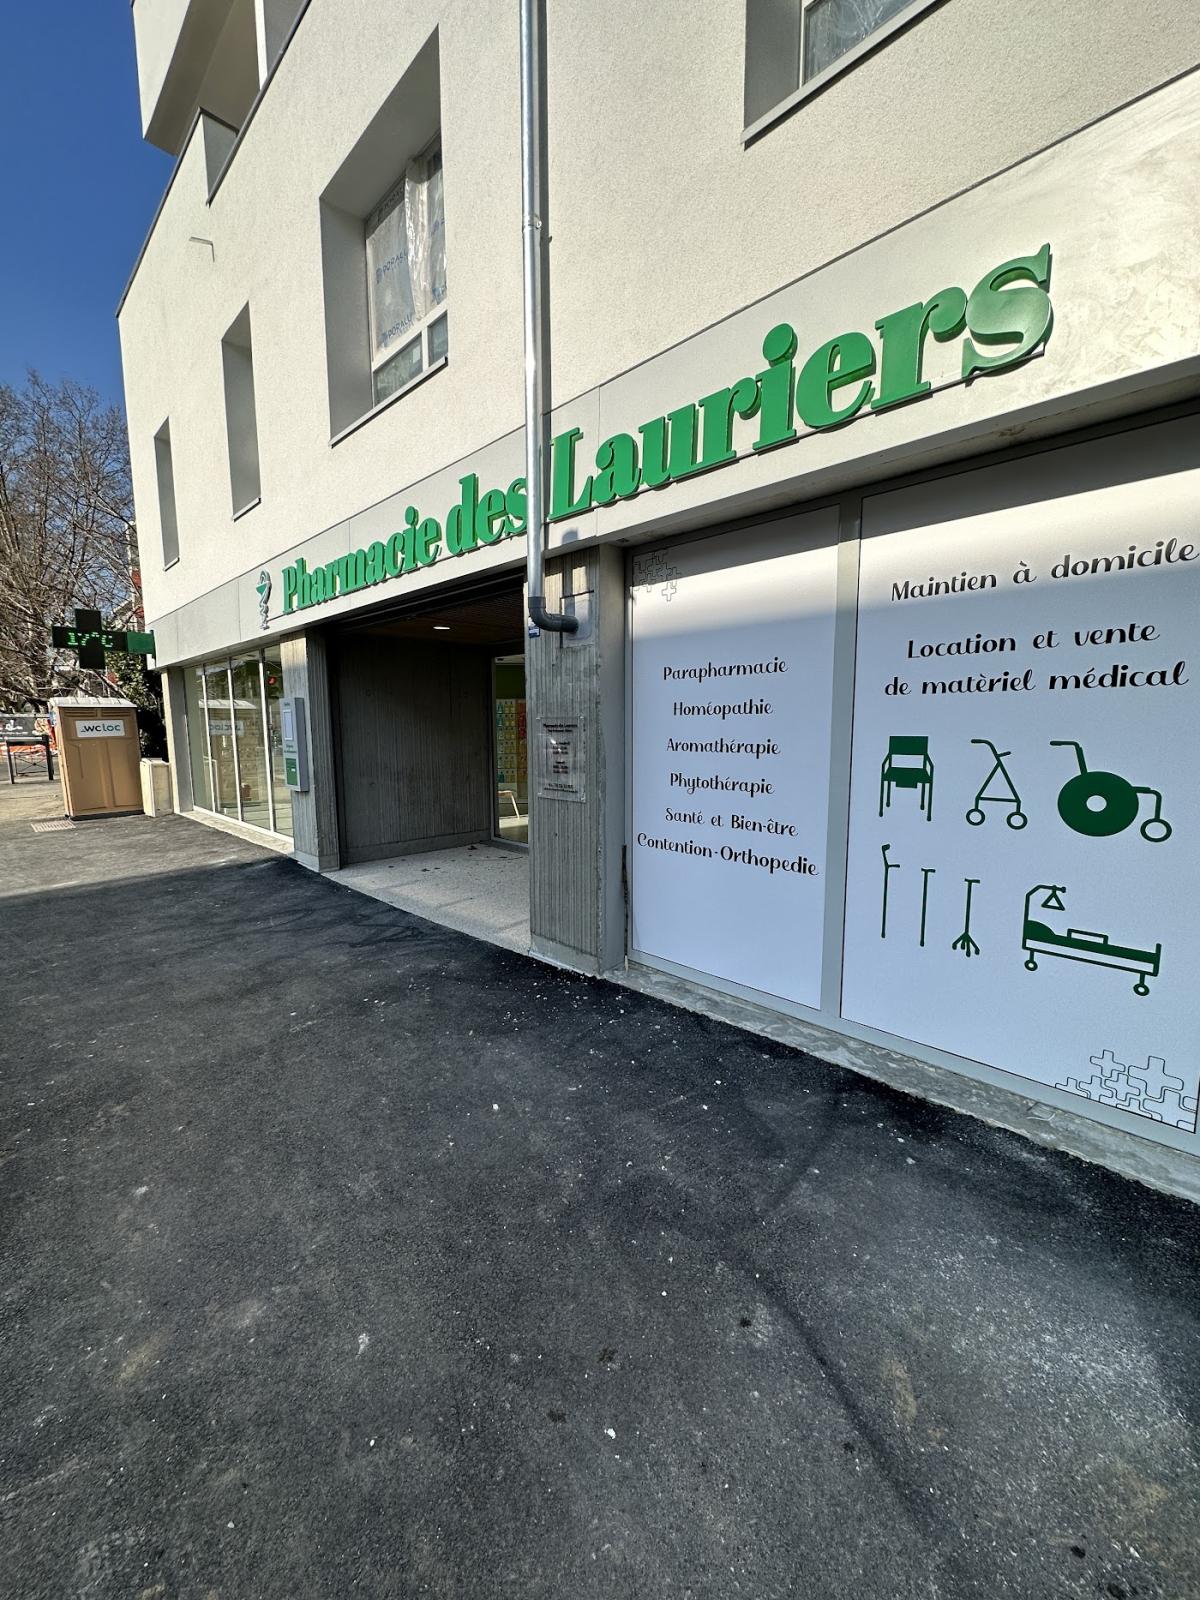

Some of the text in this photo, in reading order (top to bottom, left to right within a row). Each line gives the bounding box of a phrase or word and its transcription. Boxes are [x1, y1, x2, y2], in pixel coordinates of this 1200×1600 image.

[282, 243, 1051, 614] Pharmacie des Lauriers
[891, 537, 1200, 602] Maintien à domicile
[907, 622, 1161, 659] Location et vente
[663, 656, 788, 683] Parapharmacie
[884, 676, 912, 696] de
[1048, 660, 1190, 690] médical
[673, 698, 774, 721] Homéopathie
[667, 737, 781, 760] Aromathérapie
[670, 772, 775, 798] Phytothérapie
[665, 807, 799, 837] Santé et Bien-être
